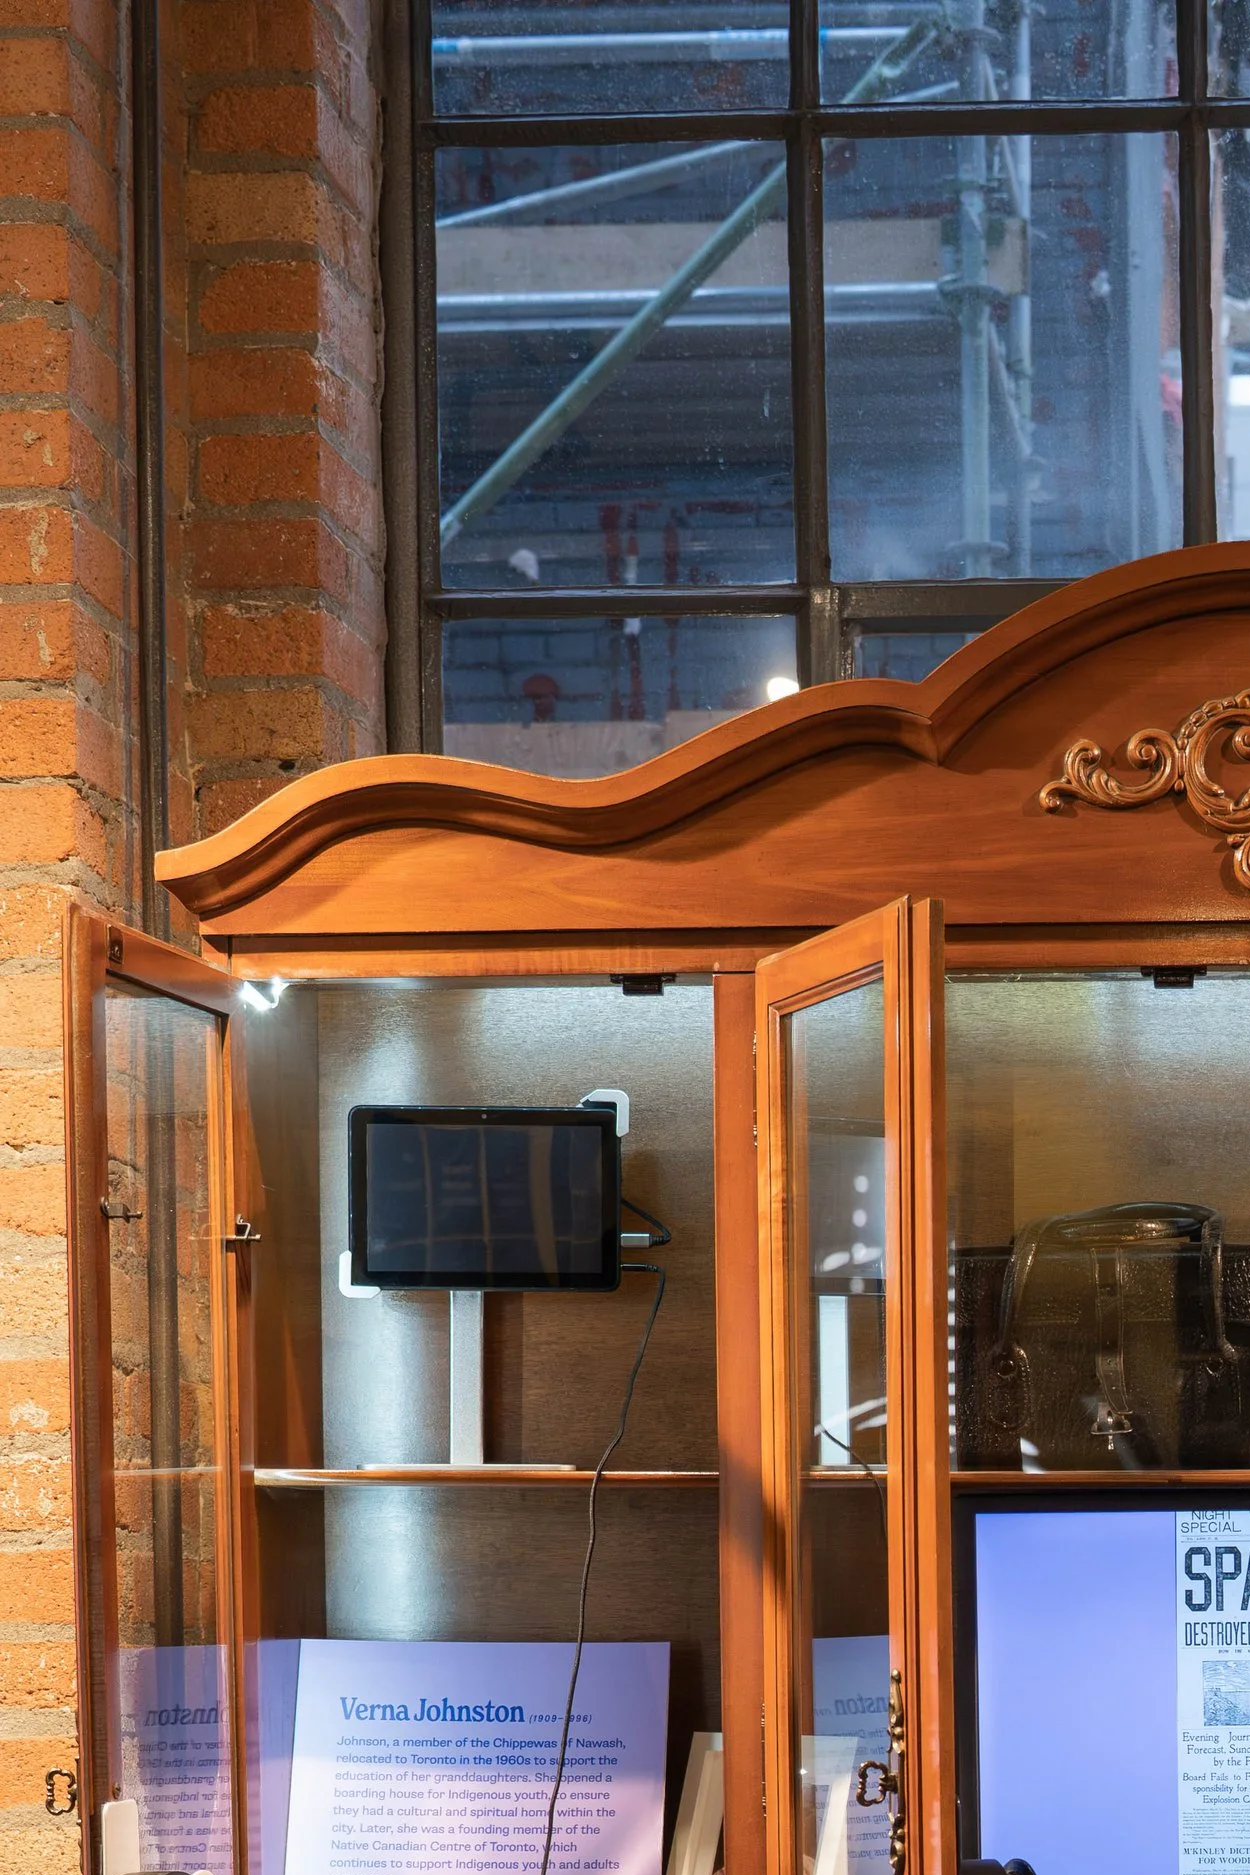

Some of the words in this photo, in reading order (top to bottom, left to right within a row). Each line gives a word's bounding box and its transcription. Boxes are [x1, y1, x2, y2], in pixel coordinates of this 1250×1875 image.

[340, 1697, 409, 1721] Verna
[414, 1698, 524, 1722] Johnston
[337, 1736, 389, 1748] Johnson,
[403, 1738, 453, 1748] member
[455, 1738, 468, 1748] of
[470, 1738, 490, 1748] the
[493, 1738, 558, 1751] Chippewas
[576, 1738, 626, 1750] Nawash,
[1182, 1732, 1219, 1743] Evening
[337, 1754, 392, 1764] relocated
[395, 1756, 407, 1764] to
[410, 1754, 456, 1765] Toronto
[460, 1755, 470, 1765] in
[473, 1755, 492, 1765] the
[495, 1755, 531, 1765] 1960s
[534, 1757, 546, 1766] to
[598, 1755, 618, 1765] the
[335, 1771, 393, 1782] education
[396, 1771, 409, 1781] of
[411, 1772, 431, 1782] her
[434, 1772, 532, 1784] granddaughters.
[534, 1772, 556, 1783] She
[605, 1775, 612, 1784] a
[334, 1788, 385, 1801] boarding
[389, 1788, 424, 1799] house
[428, 1789, 445, 1799] for
[448, 1790, 512, 1802] Indigenous
[514, 1790, 552, 1802] youth,
[333, 1806, 359, 1818] they
[363, 1806, 383, 1816] had
[397, 1806, 442, 1816] cultural
[445, 1807, 467, 1816] and
[470, 1807, 518, 1819] spiritual
[555, 1808, 593, 1817] within
[596, 1808, 616, 1817] the
[332, 1823, 355, 1835] city.
[360, 1824, 394, 1836] Later,
[397, 1824, 418, 1834] she
[458, 1824, 510, 1837] founding
[566, 1824, 578, 1834] of
[581, 1824, 600, 1834] the
[331, 1840, 369, 1850] Native
[372, 1840, 427, 1852] Canadian
[430, 1841, 471, 1852] Centre
[474, 1842, 488, 1852] of
[489, 1842, 539, 1854] Toronto,
[330, 1858, 387, 1868] continues
[390, 1860, 403, 1868] to
[406, 1860, 452, 1871] support
[456, 1859, 519, 1872] Indigenous
[559, 1860, 580, 1870] and
[583, 1860, 620, 1870] adults
